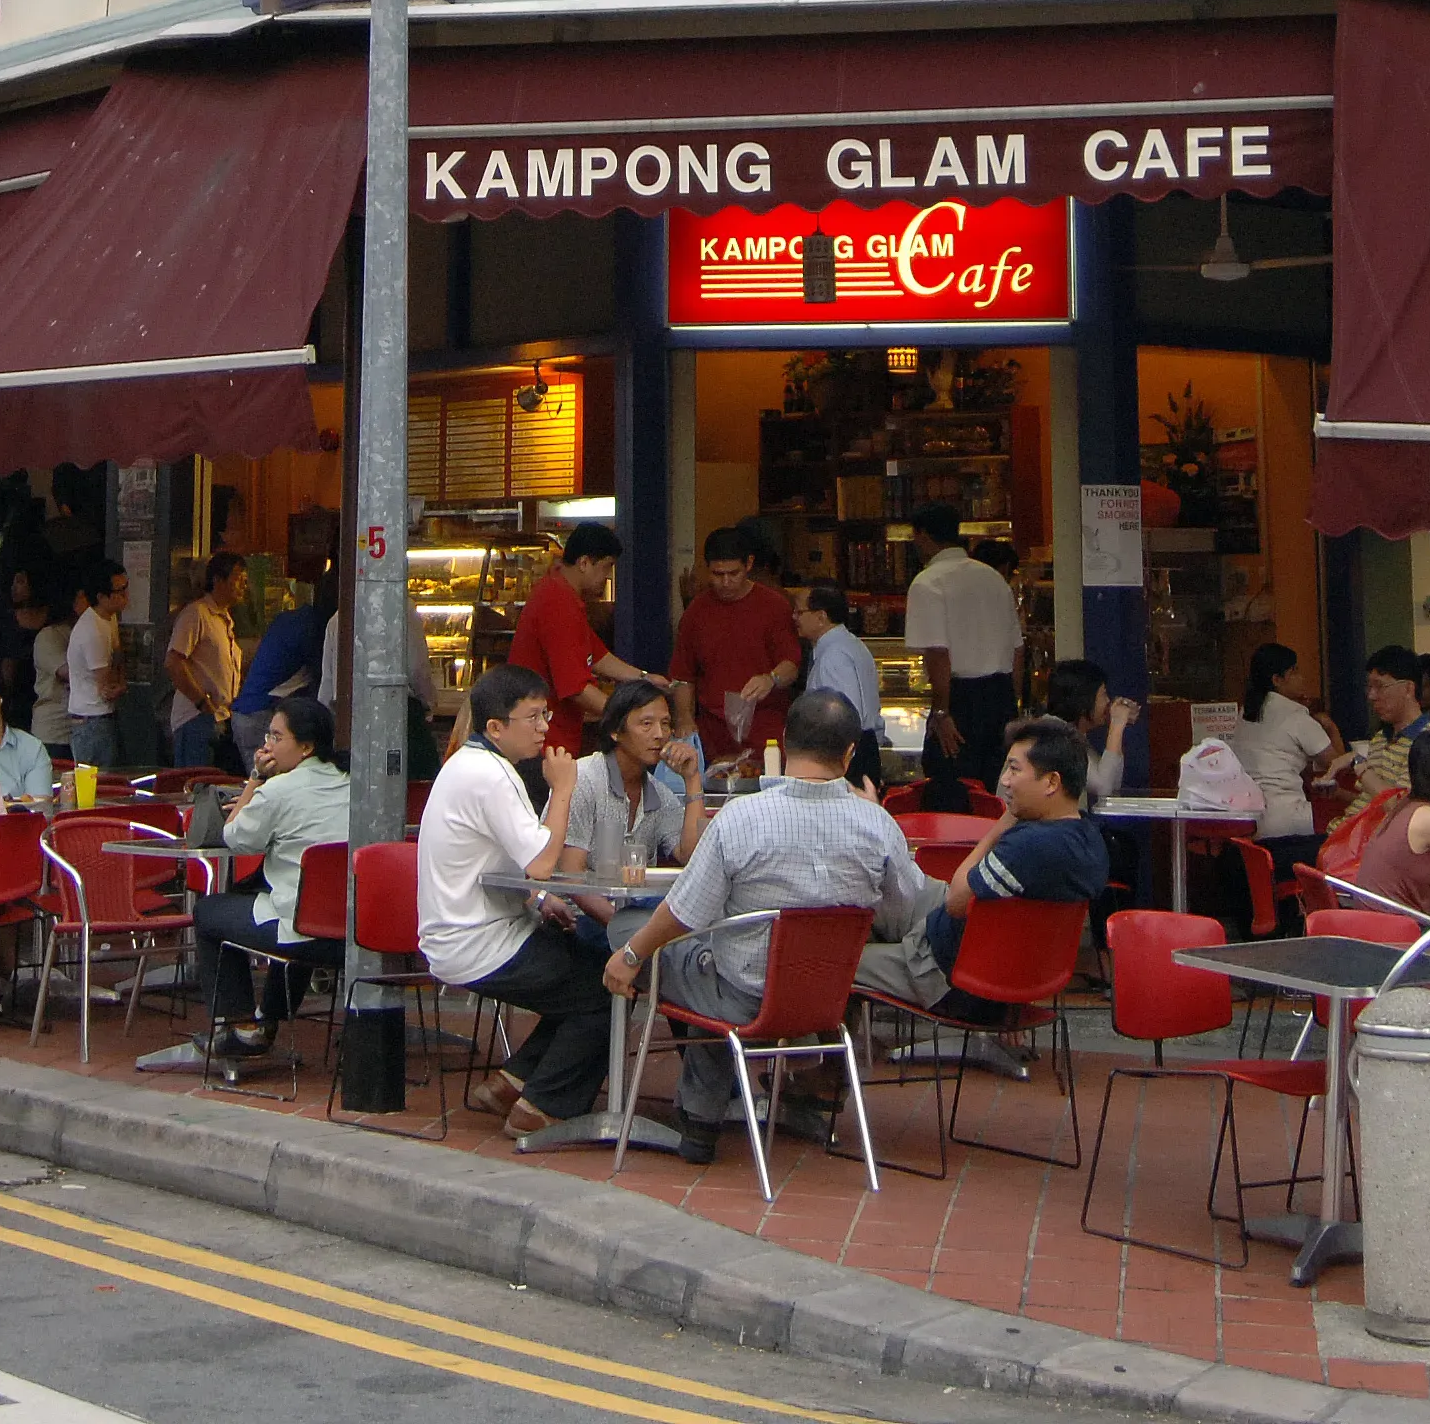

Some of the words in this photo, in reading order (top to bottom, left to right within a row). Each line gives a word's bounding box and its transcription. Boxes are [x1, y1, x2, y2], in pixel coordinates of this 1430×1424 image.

[425, 141, 771, 200] KAMPONG
[826, 134, 1027, 189] GLAM
[1083, 125, 1271, 181] CAFE
[700, 235, 854, 261] KAMPOG
[866, 233, 954, 259] GLAM
[898, 201, 1034, 308] Cafe
[1084, 487, 1121, 497] THANK
[1122, 487, 1139, 498] YOU
[1119, 521, 1140, 531] HERE
[368, 526, 386, 559] 5
